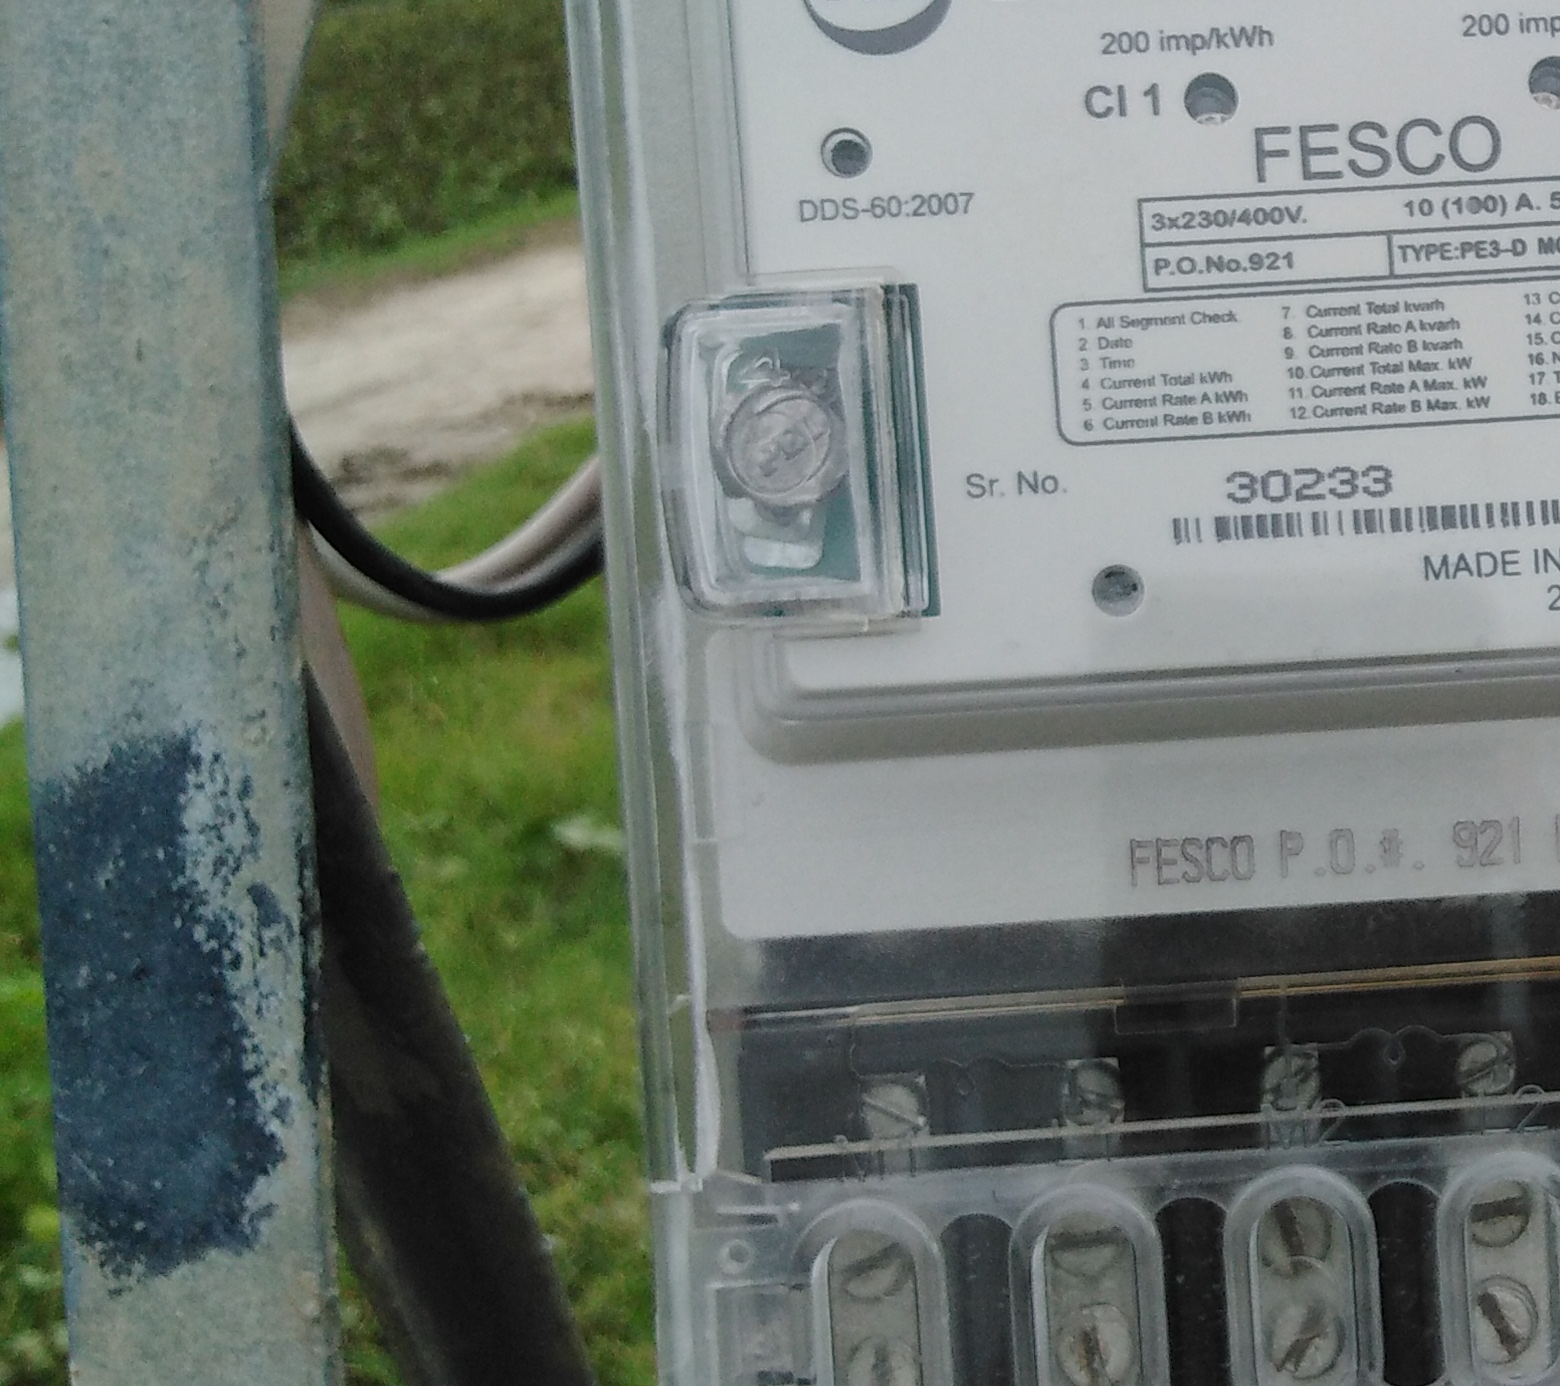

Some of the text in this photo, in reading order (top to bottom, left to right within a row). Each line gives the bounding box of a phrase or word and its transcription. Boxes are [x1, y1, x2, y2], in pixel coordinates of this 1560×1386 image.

[1462, 13, 1510, 38] 200
[1101, 27, 1274, 56] 200 imp/kWh
[1142, 83, 1161, 116] 1
[1254, 115, 1500, 183] FESCO
[799, 193, 974, 222] DDS-60:2007
[1405, 199, 1433, 218] 10
[1154, 251, 1294, 276] P.O.No.921
[1097, 317, 1115, 328] All
[1306, 304, 1361, 318] Current
[1308, 325, 1362, 338] Current
[1405, 321, 1416, 333] A
[1309, 345, 1363, 358] Current
[1310, 364, 1364, 378] Current
[1370, 362, 1404, 374] Total
[1449, 357, 1472, 370] kW
[1100, 375, 1155, 390] Current
[1161, 373, 1194, 386] Total
[1200, 371, 1232, 384] kWh
[1312, 384, 1366, 398] Current
[1409, 380, 1420, 393] A
[1464, 376, 1488, 389] kW
[1102, 396, 1157, 410] Current
[1162, 394, 1196, 406] Rate
[1201, 392, 1212, 404] A
[1216, 390, 1248, 403] kWh
[1313, 404, 1367, 419] Current
[1467, 396, 1490, 408] kW
[1103, 416, 1158, 430] Current
[1164, 414, 1198, 426] Rate
[1203, 412, 1213, 424] B
[1218, 410, 1251, 423] kWh
[966, 471, 1066, 499] Sr. No.
[1226, 464, 1393, 504] 30233
[1423, 552, 1522, 582] MADE
[1129, 833, 1255, 887] FESCO
[1453, 816, 1521, 869] 921
